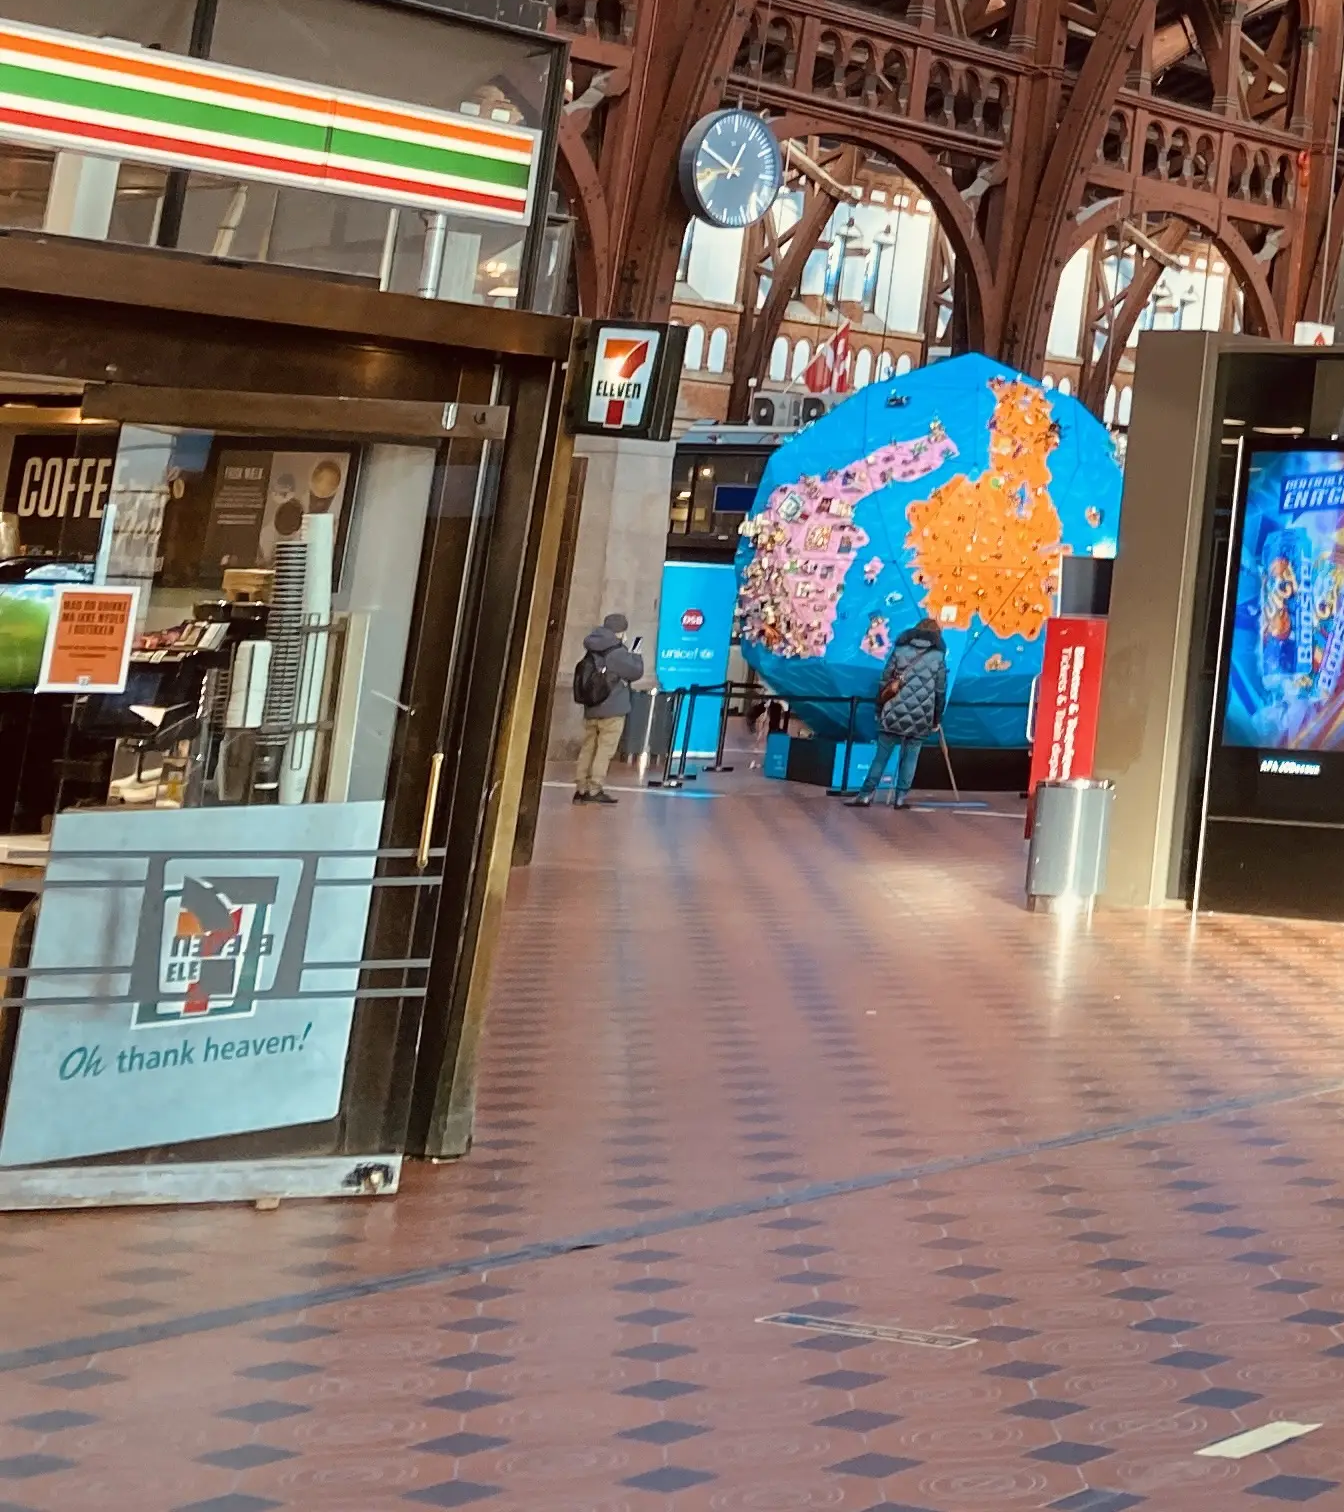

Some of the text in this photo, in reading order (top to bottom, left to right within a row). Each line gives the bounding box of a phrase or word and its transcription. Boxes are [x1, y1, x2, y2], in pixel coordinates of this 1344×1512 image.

[18, 456, 114, 519] COFFE
[661, 648, 699, 659] unicef
[59, 1021, 313, 1081] Oh thank heaven!
